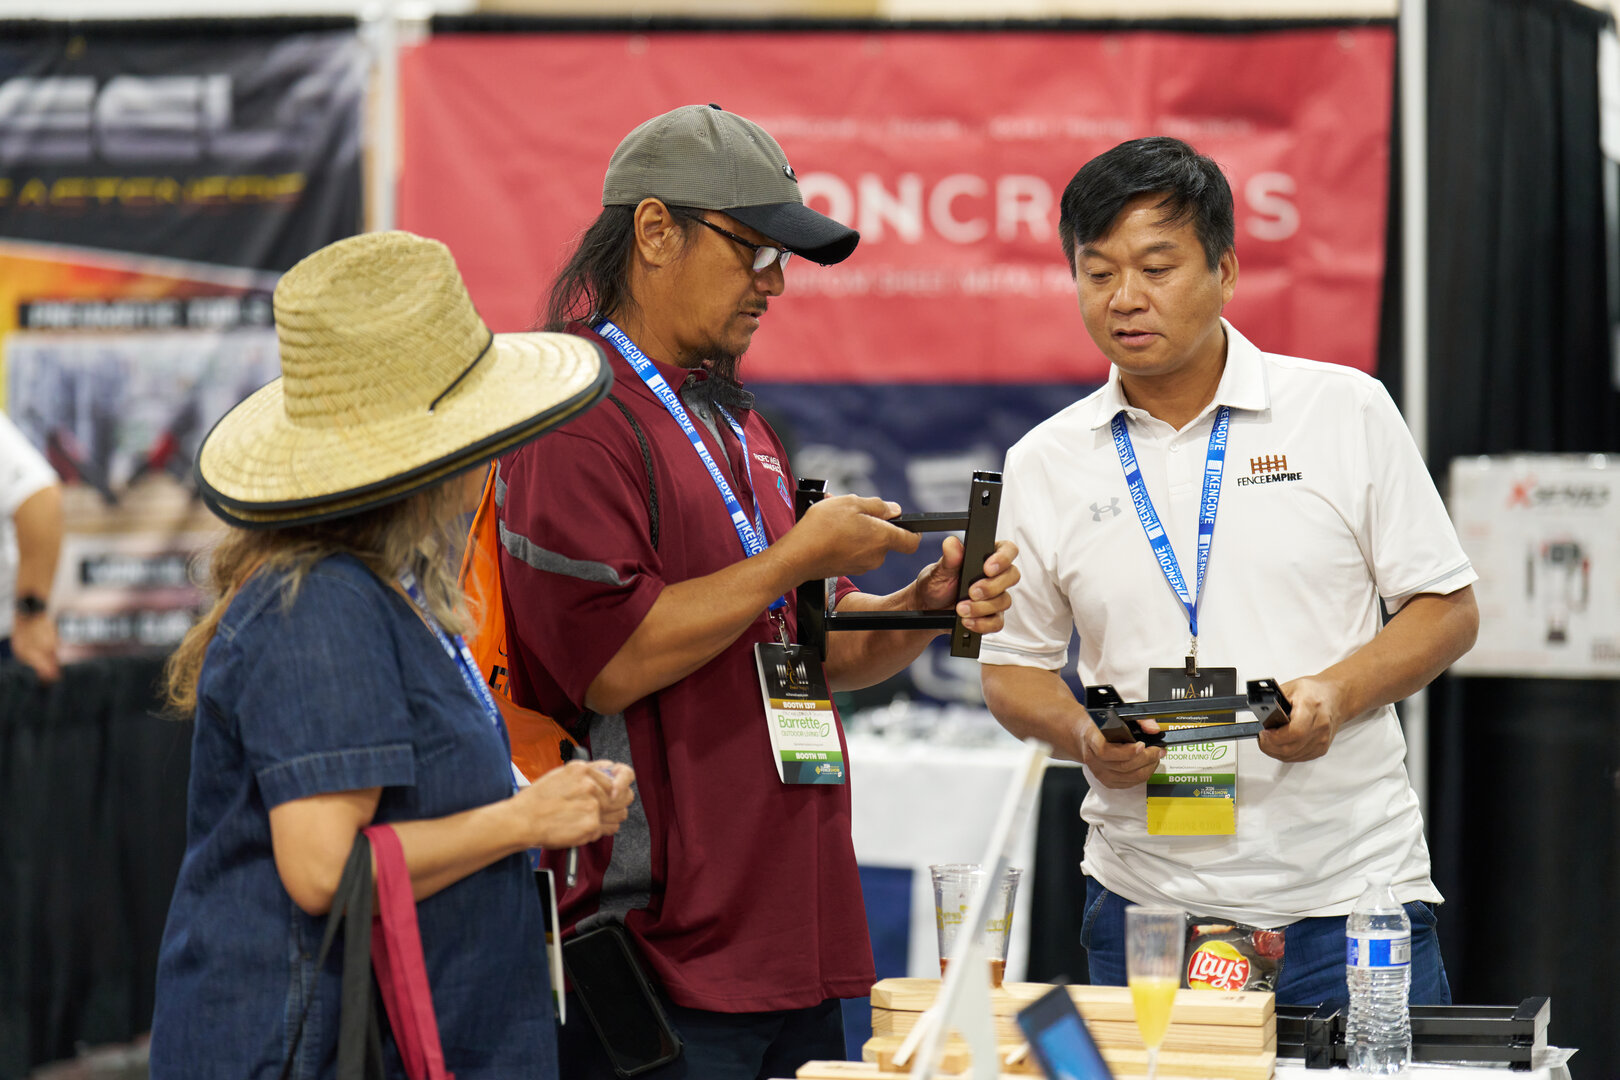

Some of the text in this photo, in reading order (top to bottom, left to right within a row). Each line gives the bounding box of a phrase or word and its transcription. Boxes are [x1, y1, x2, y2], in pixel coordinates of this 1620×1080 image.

[613, 331, 652, 371] KENCOVE
[661, 387, 696, 434] KENCOVE
[1215, 408, 1229, 451] KENCOVE
[1112, 419, 1130, 462] KENCOVE
[705, 455, 736, 504] KENCOVE
[1129, 481, 1154, 526] KENCOVE
[1205, 476, 1221, 524] KENCOVE
[742, 525, 764, 556] KENC
[1155, 546, 1184, 590] KENCOVE
[777, 714, 820, 729] Barrette
[783, 701, 804, 709] BOOTH
[795, 752, 817, 760] BOOTH
[1165, 742, 1215, 752] arrette
[1189, 753, 1210, 761] LIVING
[1168, 775, 1213, 783] BOOTH 1111
[1190, 951, 1247, 988] Lay's
